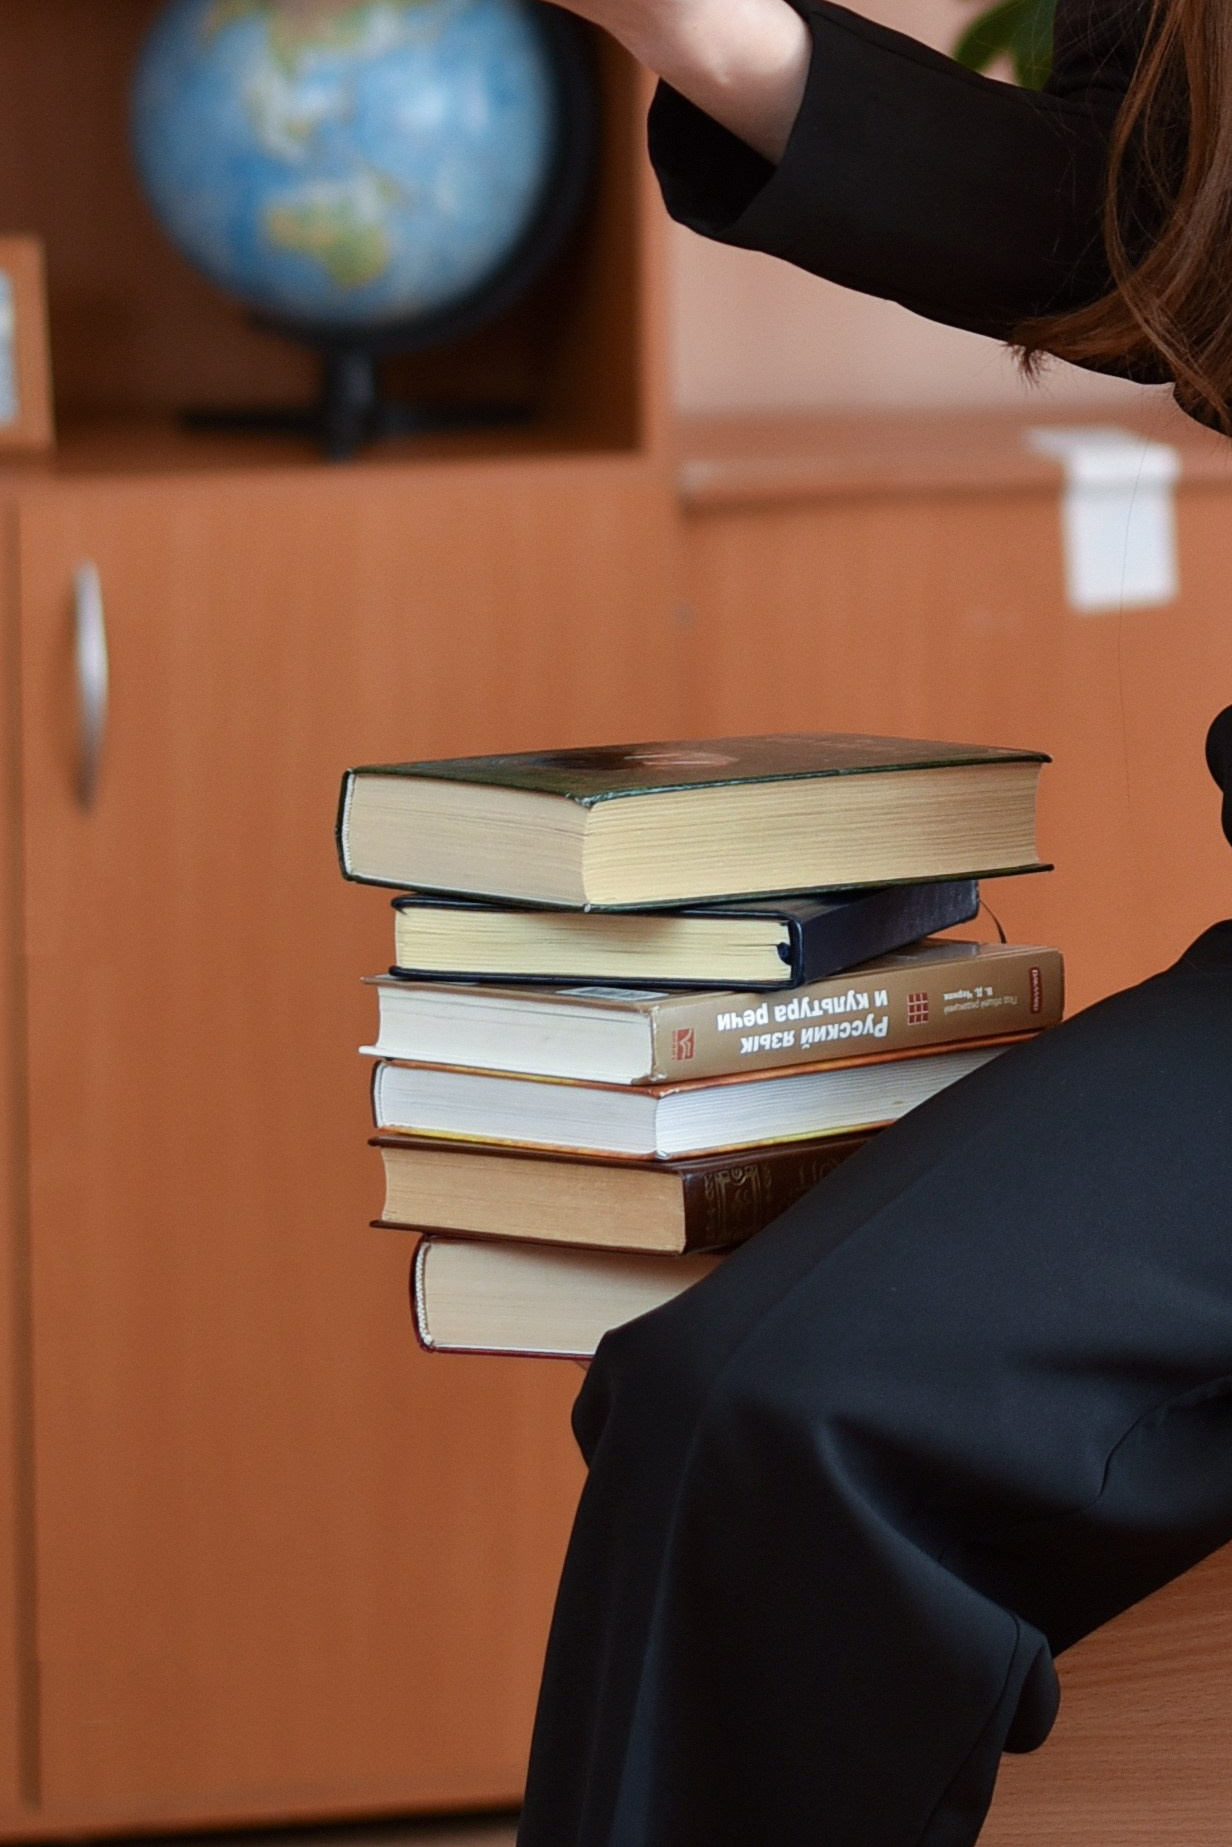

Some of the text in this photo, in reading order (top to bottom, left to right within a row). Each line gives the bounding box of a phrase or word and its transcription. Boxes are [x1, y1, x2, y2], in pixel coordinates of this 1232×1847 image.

[717, 989, 888, 1031] и культура речи
[740, 1013, 888, 1054] Русский язык
